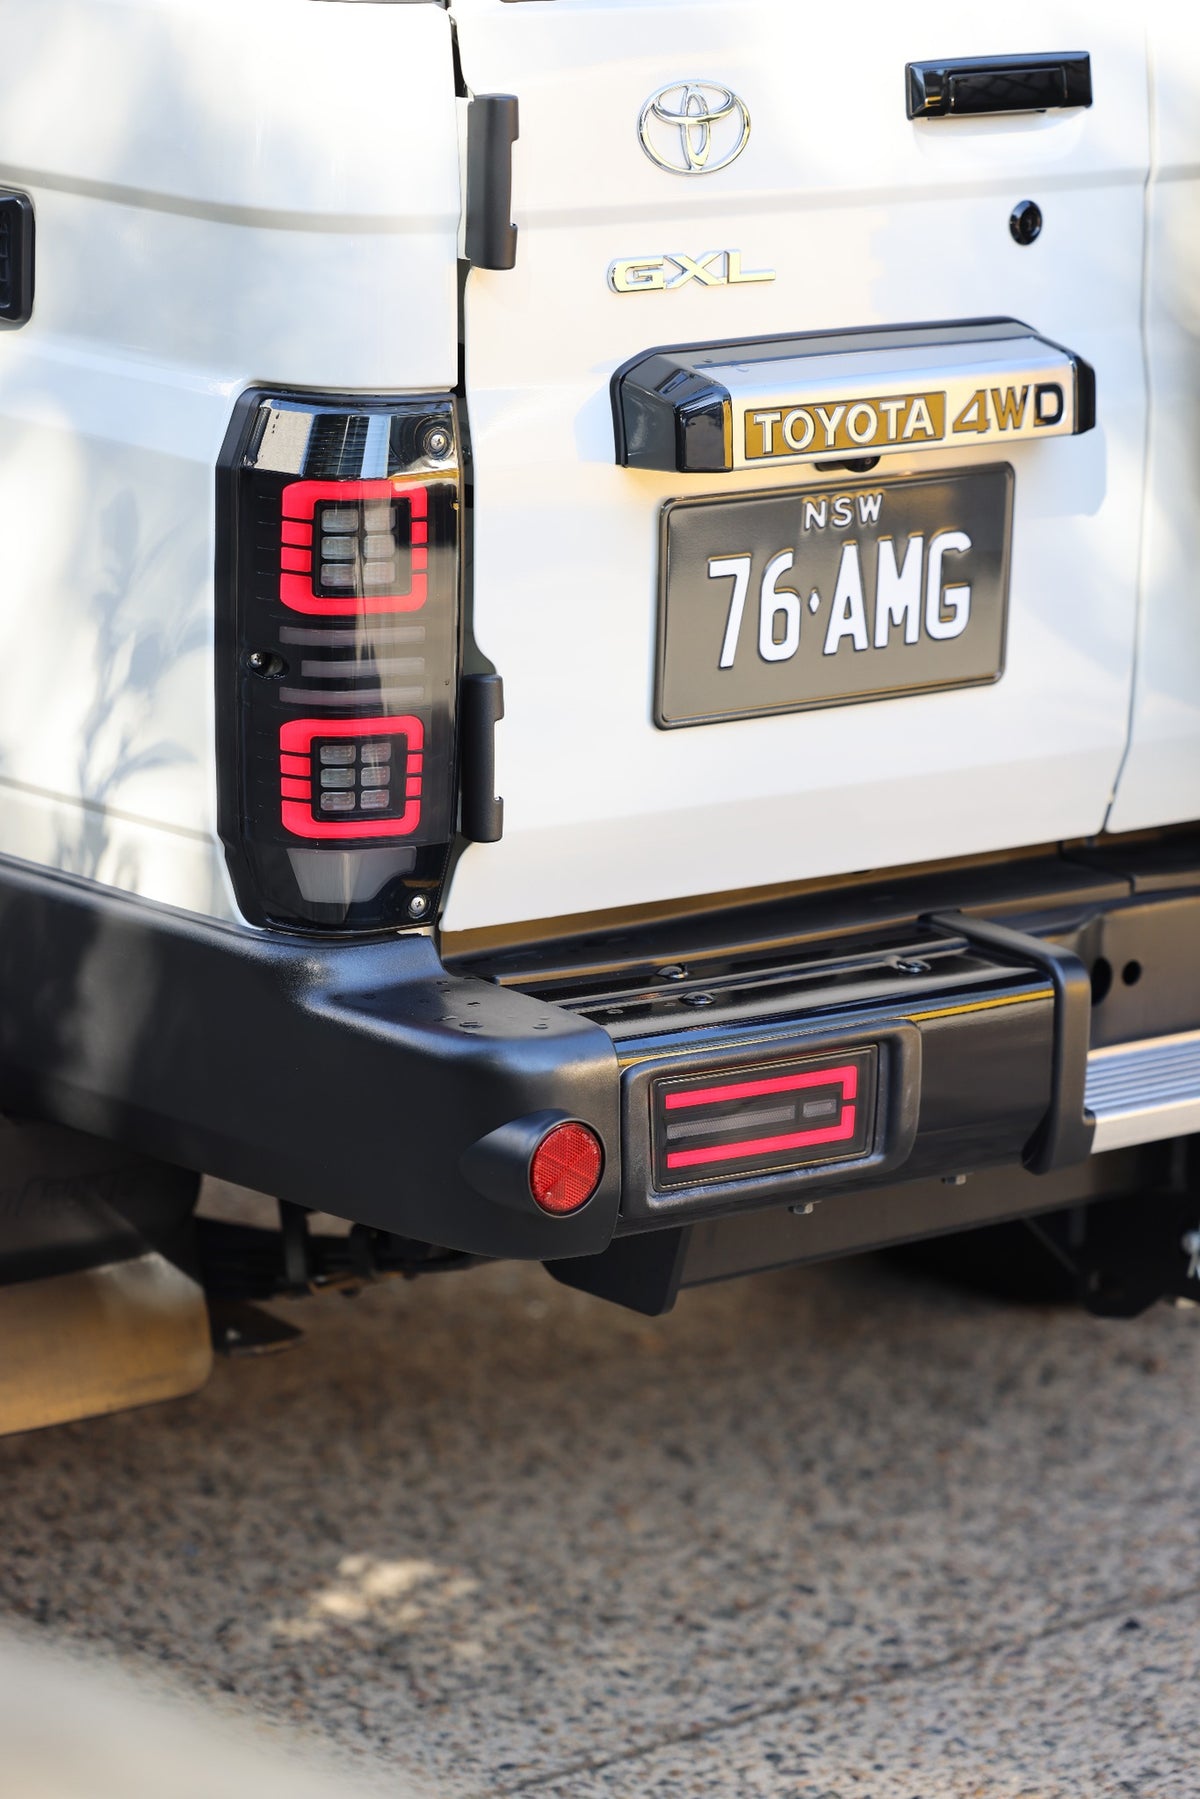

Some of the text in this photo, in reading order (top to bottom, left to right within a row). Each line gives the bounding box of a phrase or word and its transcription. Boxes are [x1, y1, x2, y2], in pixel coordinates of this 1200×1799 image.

[606, 250, 775, 293] GXL
[753, 382, 1064, 454] TOYOTA 4WD
[803, 494, 883, 530] NSW
